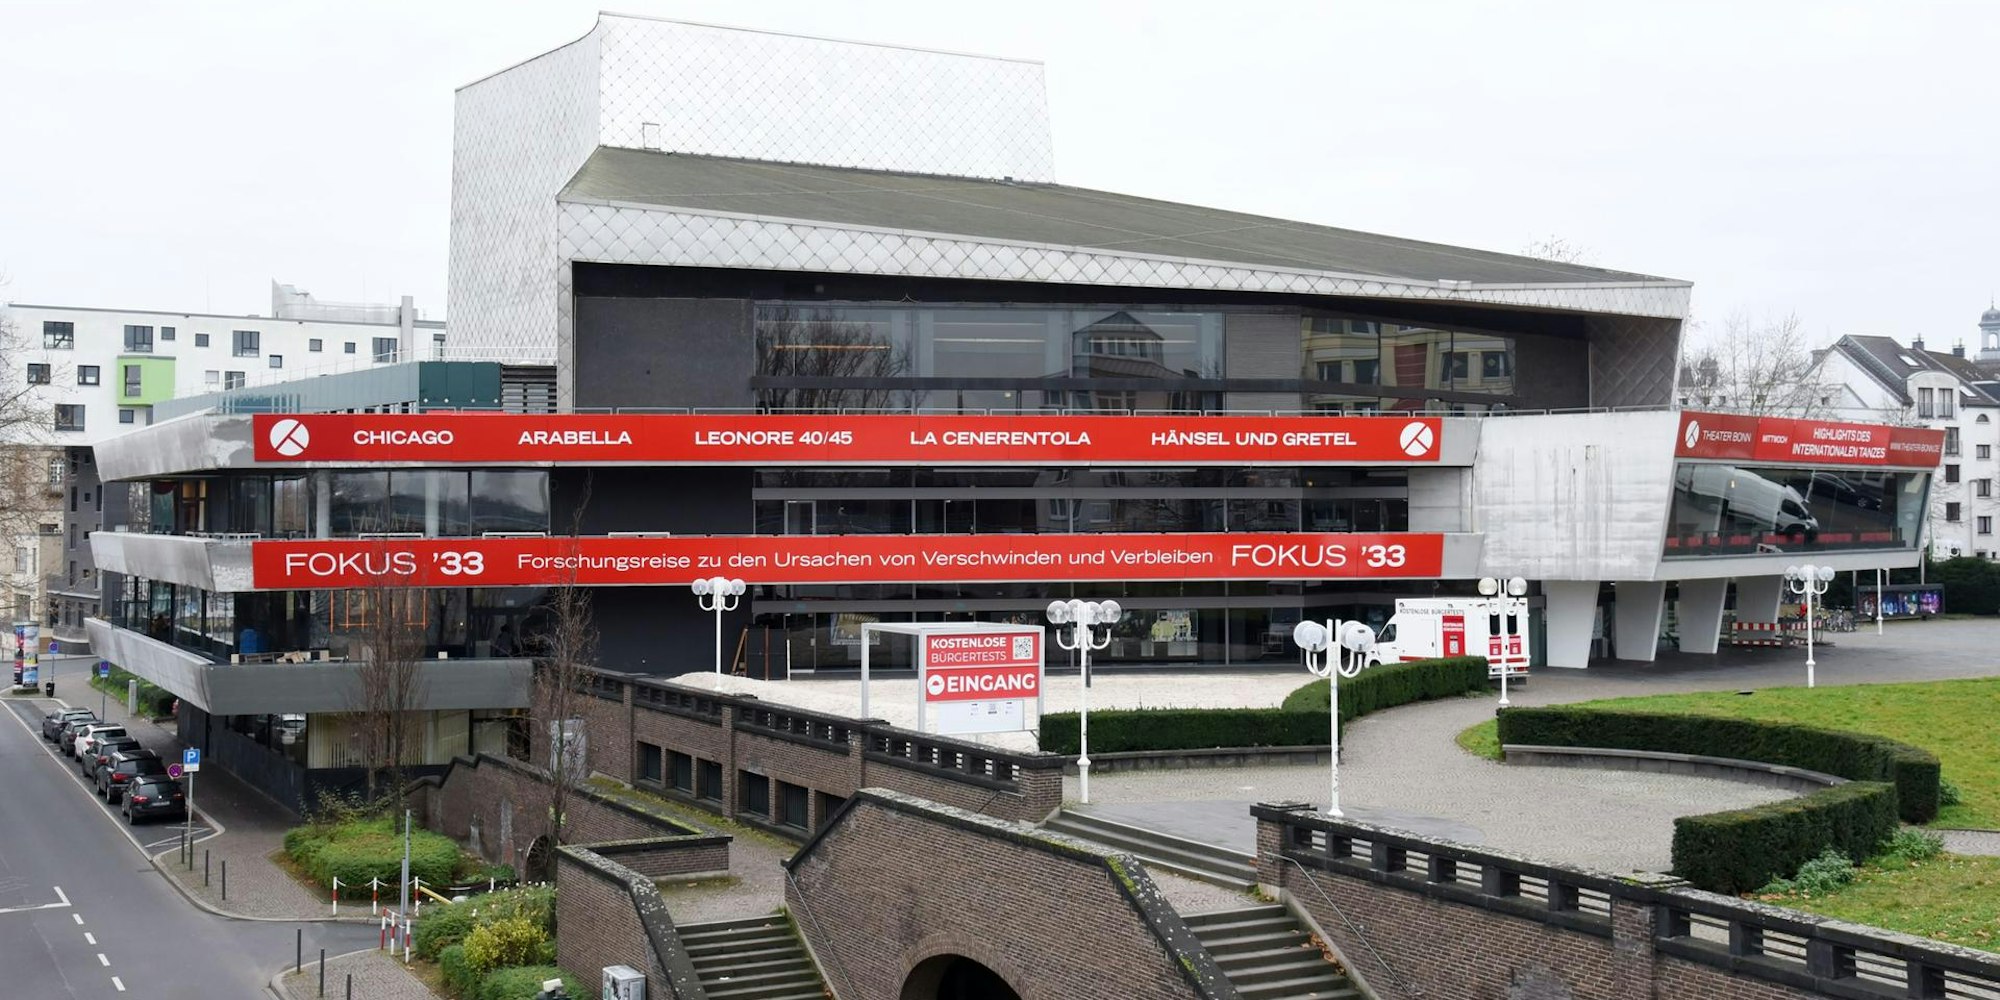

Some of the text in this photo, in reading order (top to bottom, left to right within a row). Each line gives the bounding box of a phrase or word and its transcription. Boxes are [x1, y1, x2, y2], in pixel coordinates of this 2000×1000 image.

[353, 430, 454, 445] CHICAGO
[518, 430, 633, 445] ARABELLA
[695, 430, 853, 446] LEONORE 40/45
[910, 431, 1092, 446] LA CENERENTOLA
[1151, 429, 1357, 447] HÄNSEL UND GRETEL
[1703, 430, 1752, 443] THEATER BONN
[1813, 428, 1871, 442] HIGHLIGHTS DES
[1792, 443, 1886, 459] INTERNATIONALEN TANZES
[518, 549, 1214, 572] Forschungsreise zu den Ursachen von Verschwinden und Verbleiben
[1231, 544, 1347, 567] FOKUS
[285, 551, 417, 576] FOKUS
[931, 637, 1007, 649] KOSTENLOSE
[931, 651, 1007, 663] BÜRGERTESTS
[947, 673, 1036, 693] EINGANG
[187, 751, 196, 762] P
